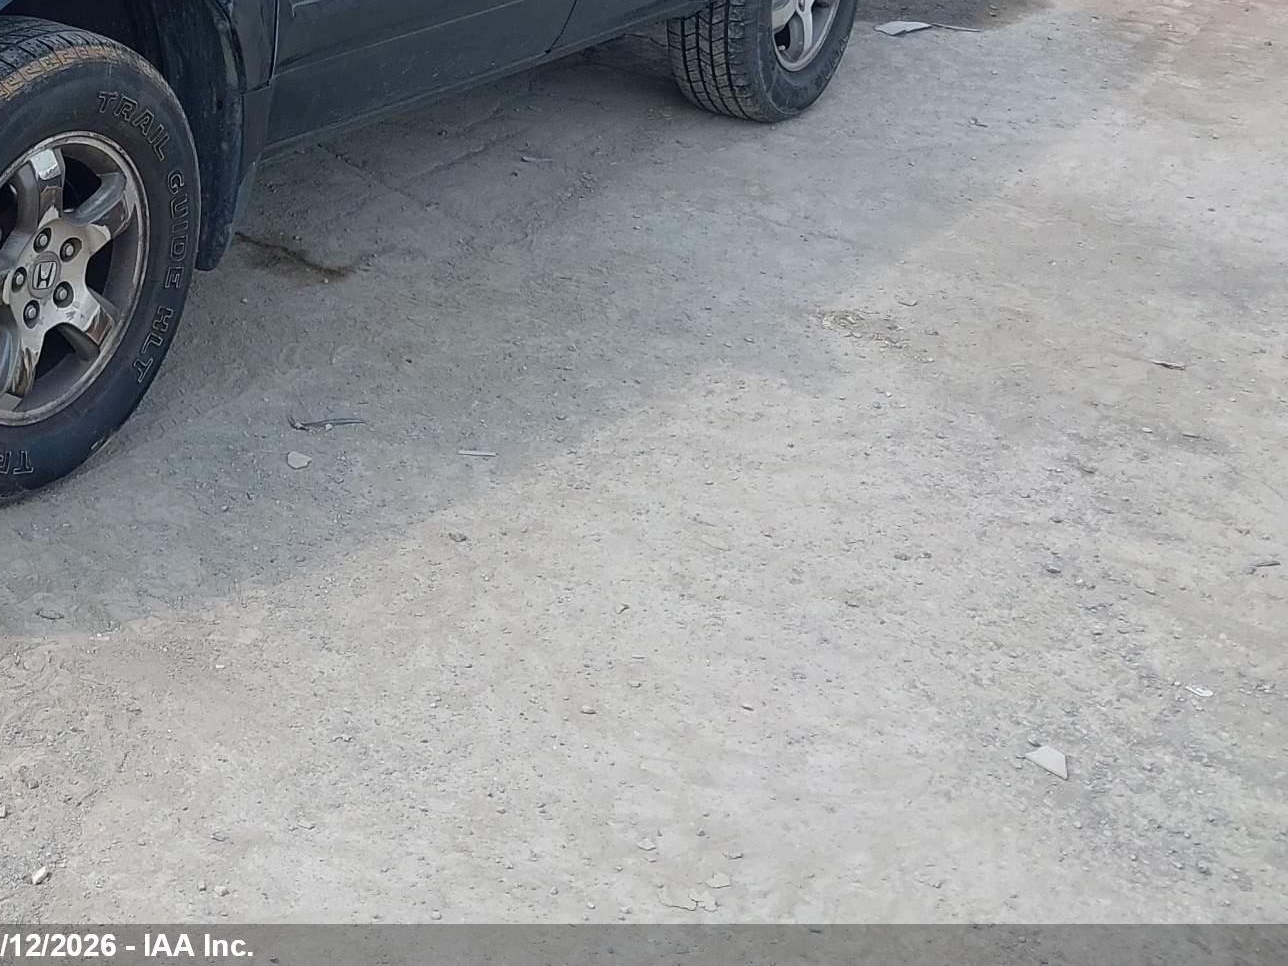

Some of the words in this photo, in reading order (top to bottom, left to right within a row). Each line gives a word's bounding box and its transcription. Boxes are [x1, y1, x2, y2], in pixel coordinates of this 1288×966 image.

[98, 91, 170, 161] TRAIL
[165, 169, 189, 289] GUIDE
[134, 306, 173, 383] HLT
